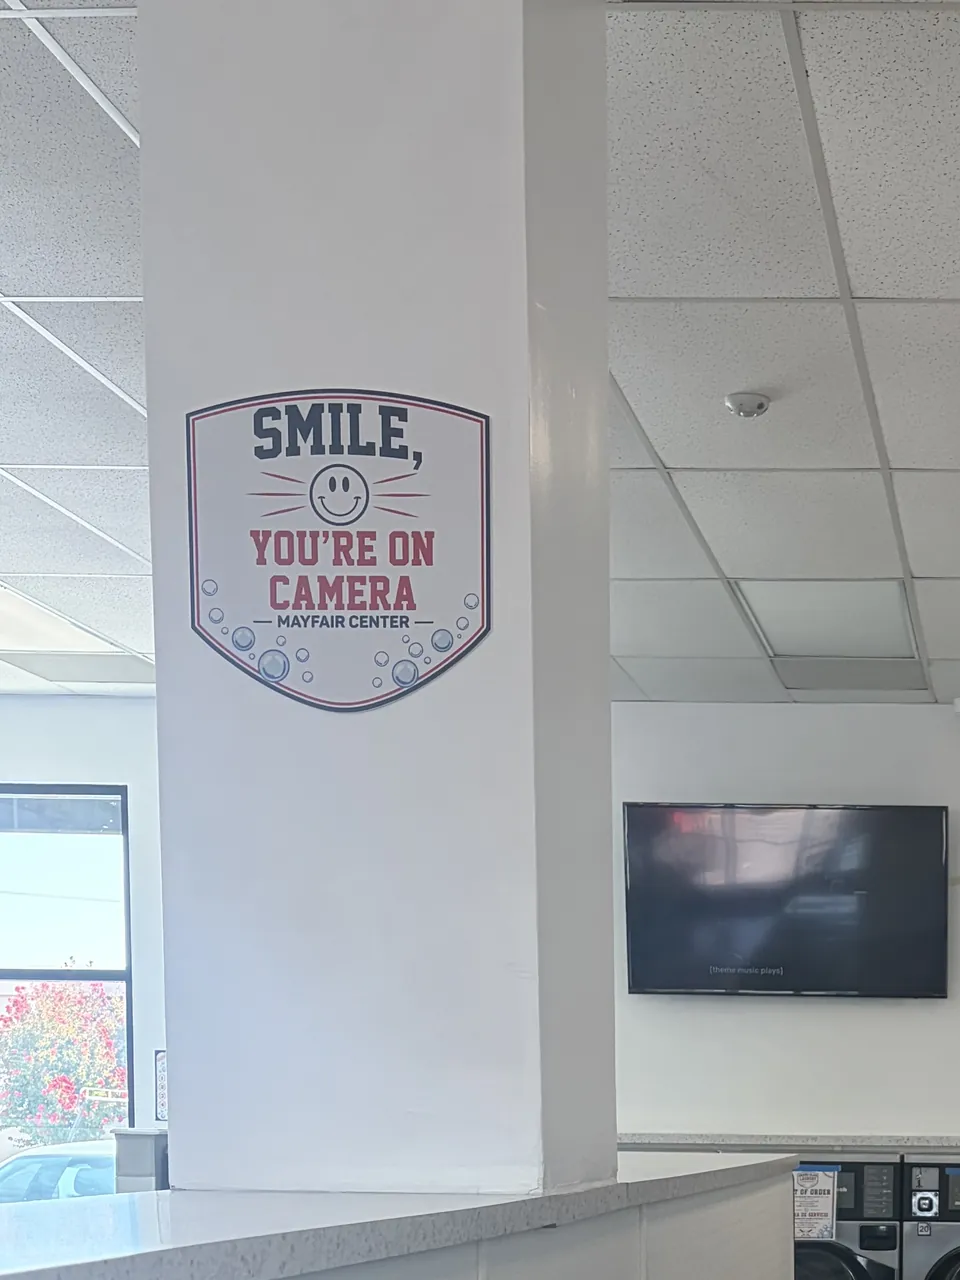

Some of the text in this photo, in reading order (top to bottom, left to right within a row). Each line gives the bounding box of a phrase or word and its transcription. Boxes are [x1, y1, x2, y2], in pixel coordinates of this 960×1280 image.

[253, 403, 422, 470] SMILE,
[250, 530, 435, 566] YOU'RE ON
[269, 575, 417, 610] CAMERA
[277, 615, 410, 628] MAYFAIR CENTER
[919, 1225, 929, 1233] 20
